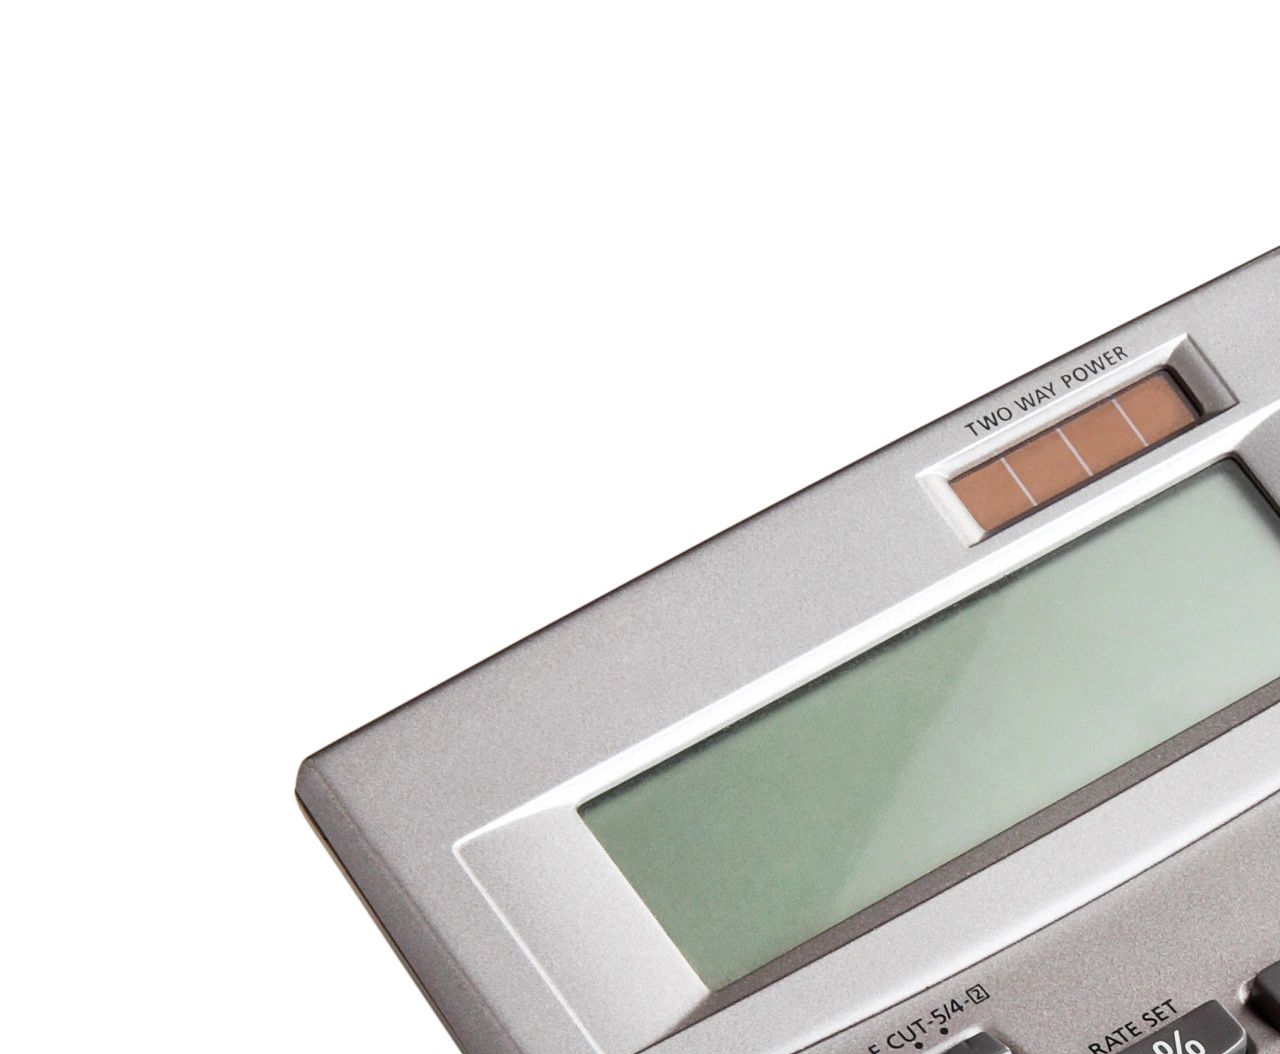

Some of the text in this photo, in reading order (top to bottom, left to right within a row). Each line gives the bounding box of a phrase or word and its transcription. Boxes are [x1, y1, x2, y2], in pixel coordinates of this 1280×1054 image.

[964, 345, 1129, 438] TWO WAY POWER
[1142, 999, 1180, 1029] SET
